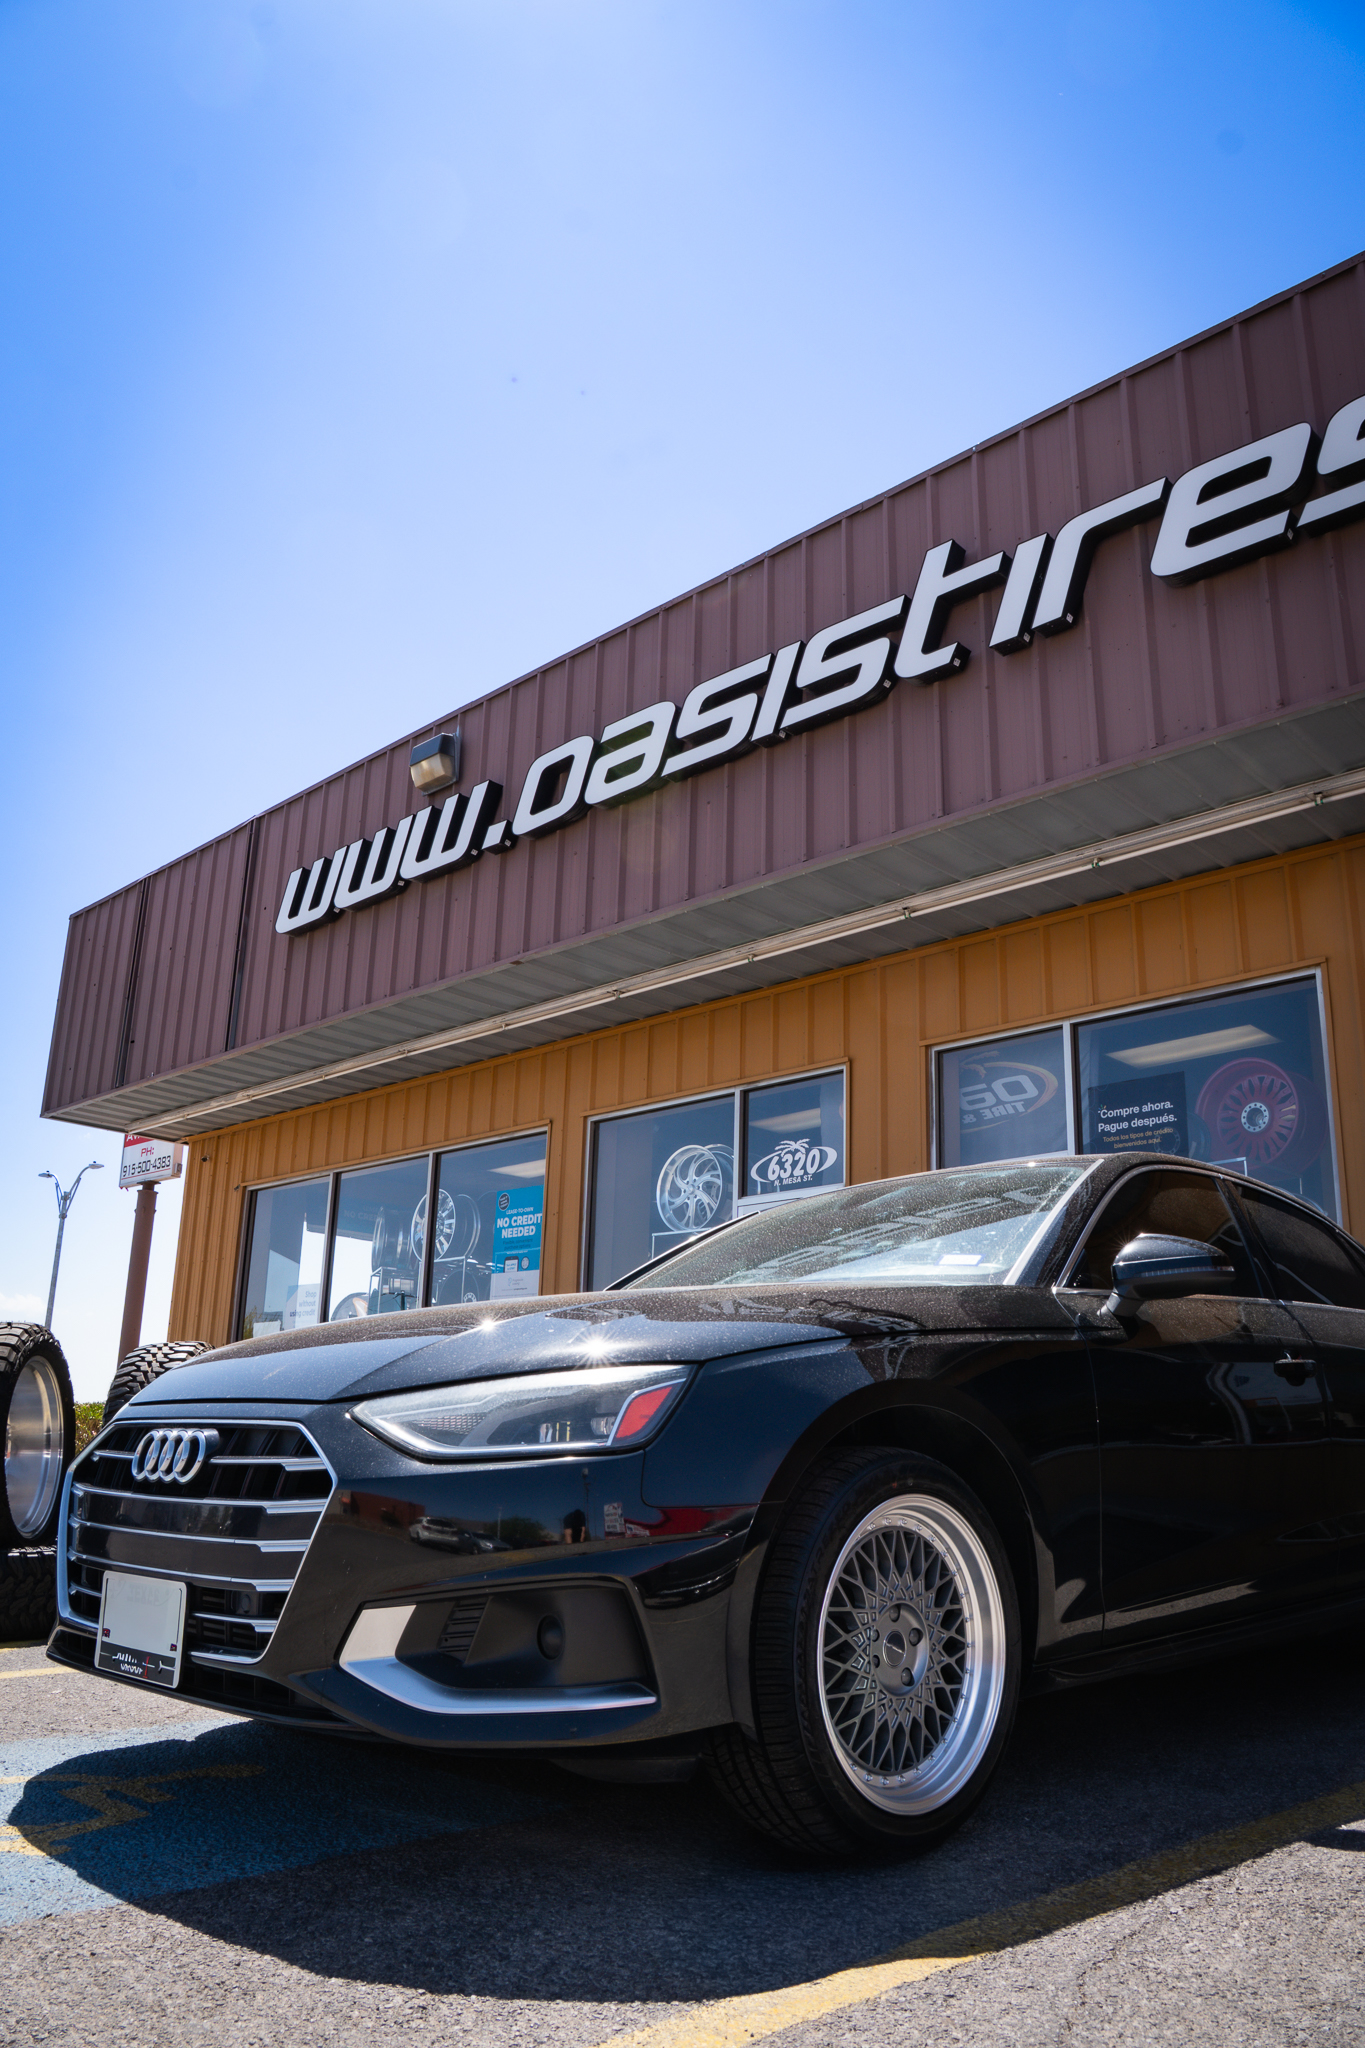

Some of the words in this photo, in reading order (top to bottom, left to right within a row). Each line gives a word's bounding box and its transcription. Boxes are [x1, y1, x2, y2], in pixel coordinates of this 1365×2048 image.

[1100, 1105, 1140, 1119] Compre
[1141, 1101, 1174, 1113] ahora.
[1098, 1121, 1129, 1133] Pague
[1130, 1112, 1178, 1128] después.
[1102, 1135, 1120, 1143] Todos
[1153, 1127, 1174, 1136] crédito
[1113, 1139, 1148, 1149] bienvenidos
[140, 1146, 154, 1157] PH:
[122, 1155, 171, 1177] 915-500-4383
[767, 1148, 820, 1181] 6320
[782, 1176, 801, 1185] MESA
[802, 1174, 813, 1182] ST.
[496, 1217, 510, 1228] NO
[511, 1213, 542, 1226] CREDIT
[501, 1225, 536, 1238] NEEDED
[305, 1290, 317, 1299] Shop
[299, 1300, 316, 1308] without
[289, 1309, 301, 1318] using
